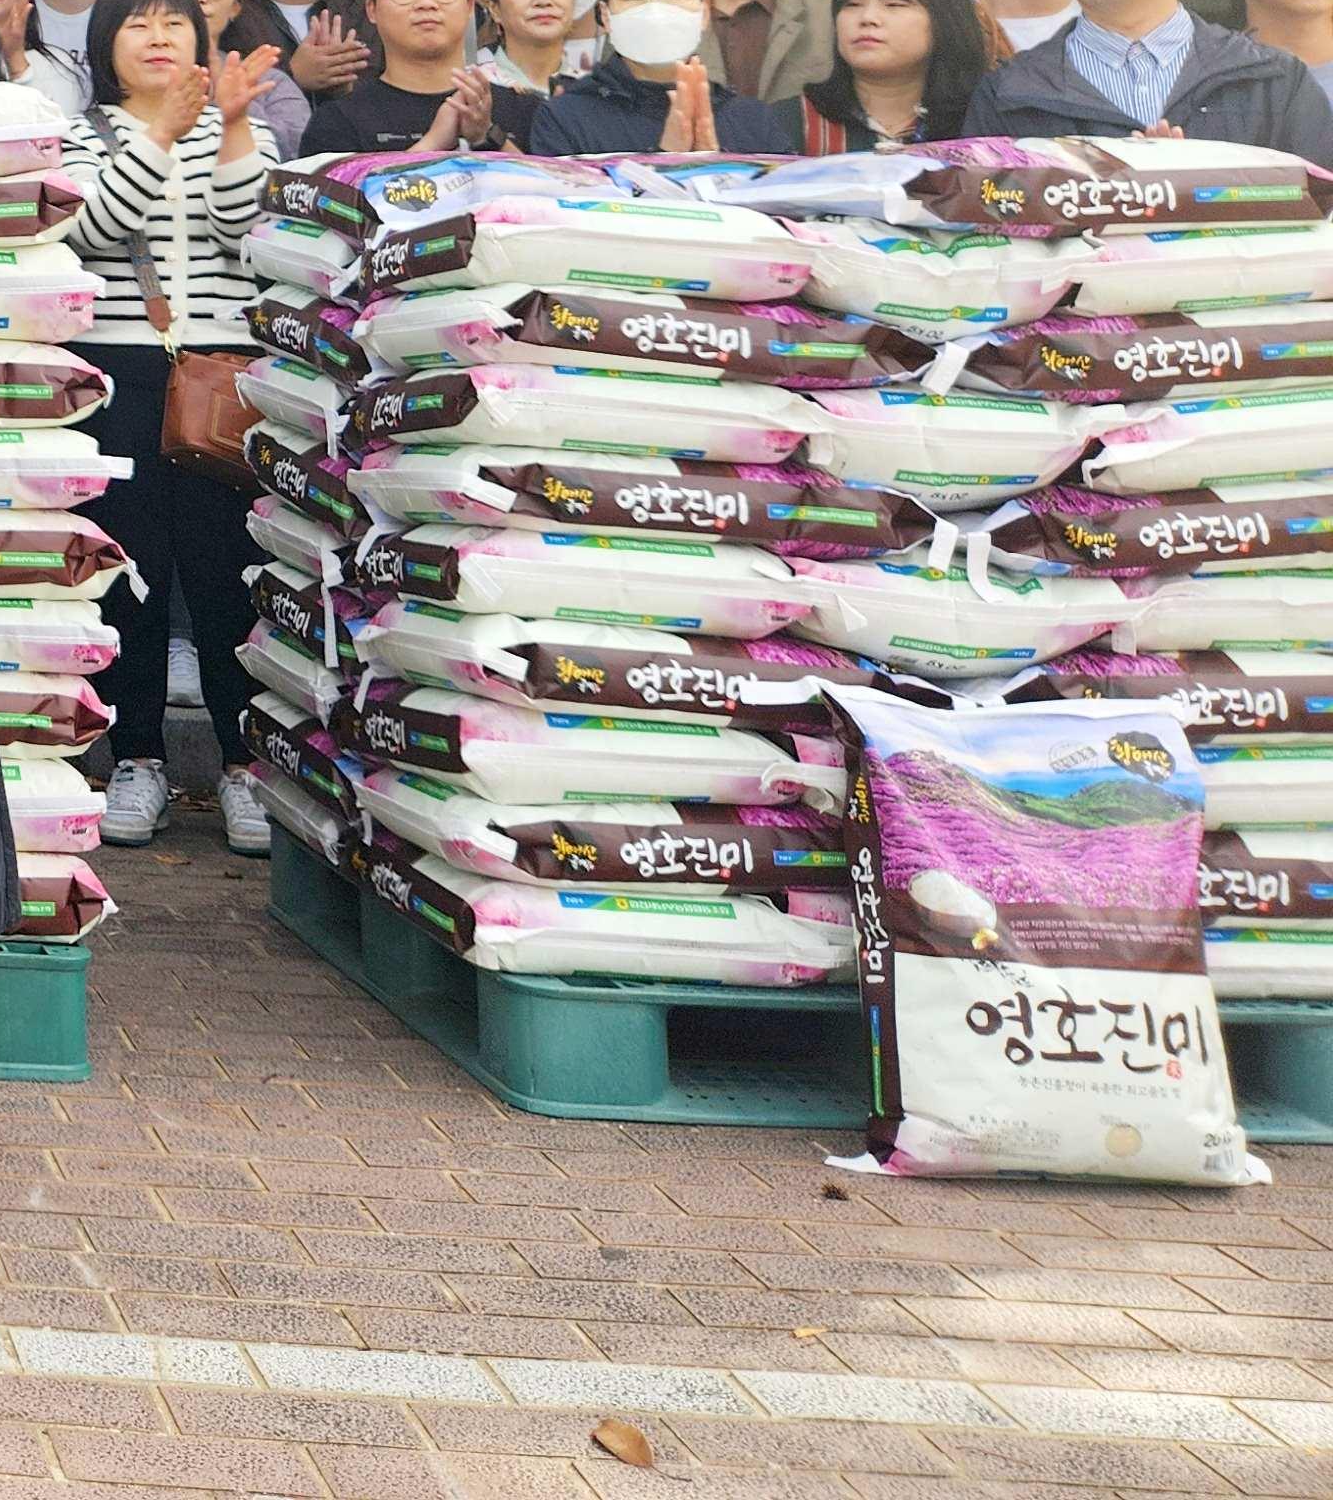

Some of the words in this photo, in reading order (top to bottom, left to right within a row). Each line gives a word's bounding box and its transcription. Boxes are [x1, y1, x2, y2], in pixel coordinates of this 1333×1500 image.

[1043, 175, 1177, 219] 영호진미
[620, 312, 752, 361] 영호진미
[1113, 336, 1244, 382] 영호진미
[614, 481, 749, 529] 영호진미
[1139, 513, 1271, 560] 영호진미
[619, 830, 754, 878] 영호진미
[1196, 862, 1289, 911] 호진미
[851, 847, 890, 984] 영호진미
[966, 985, 1209, 1074] 영호진미
